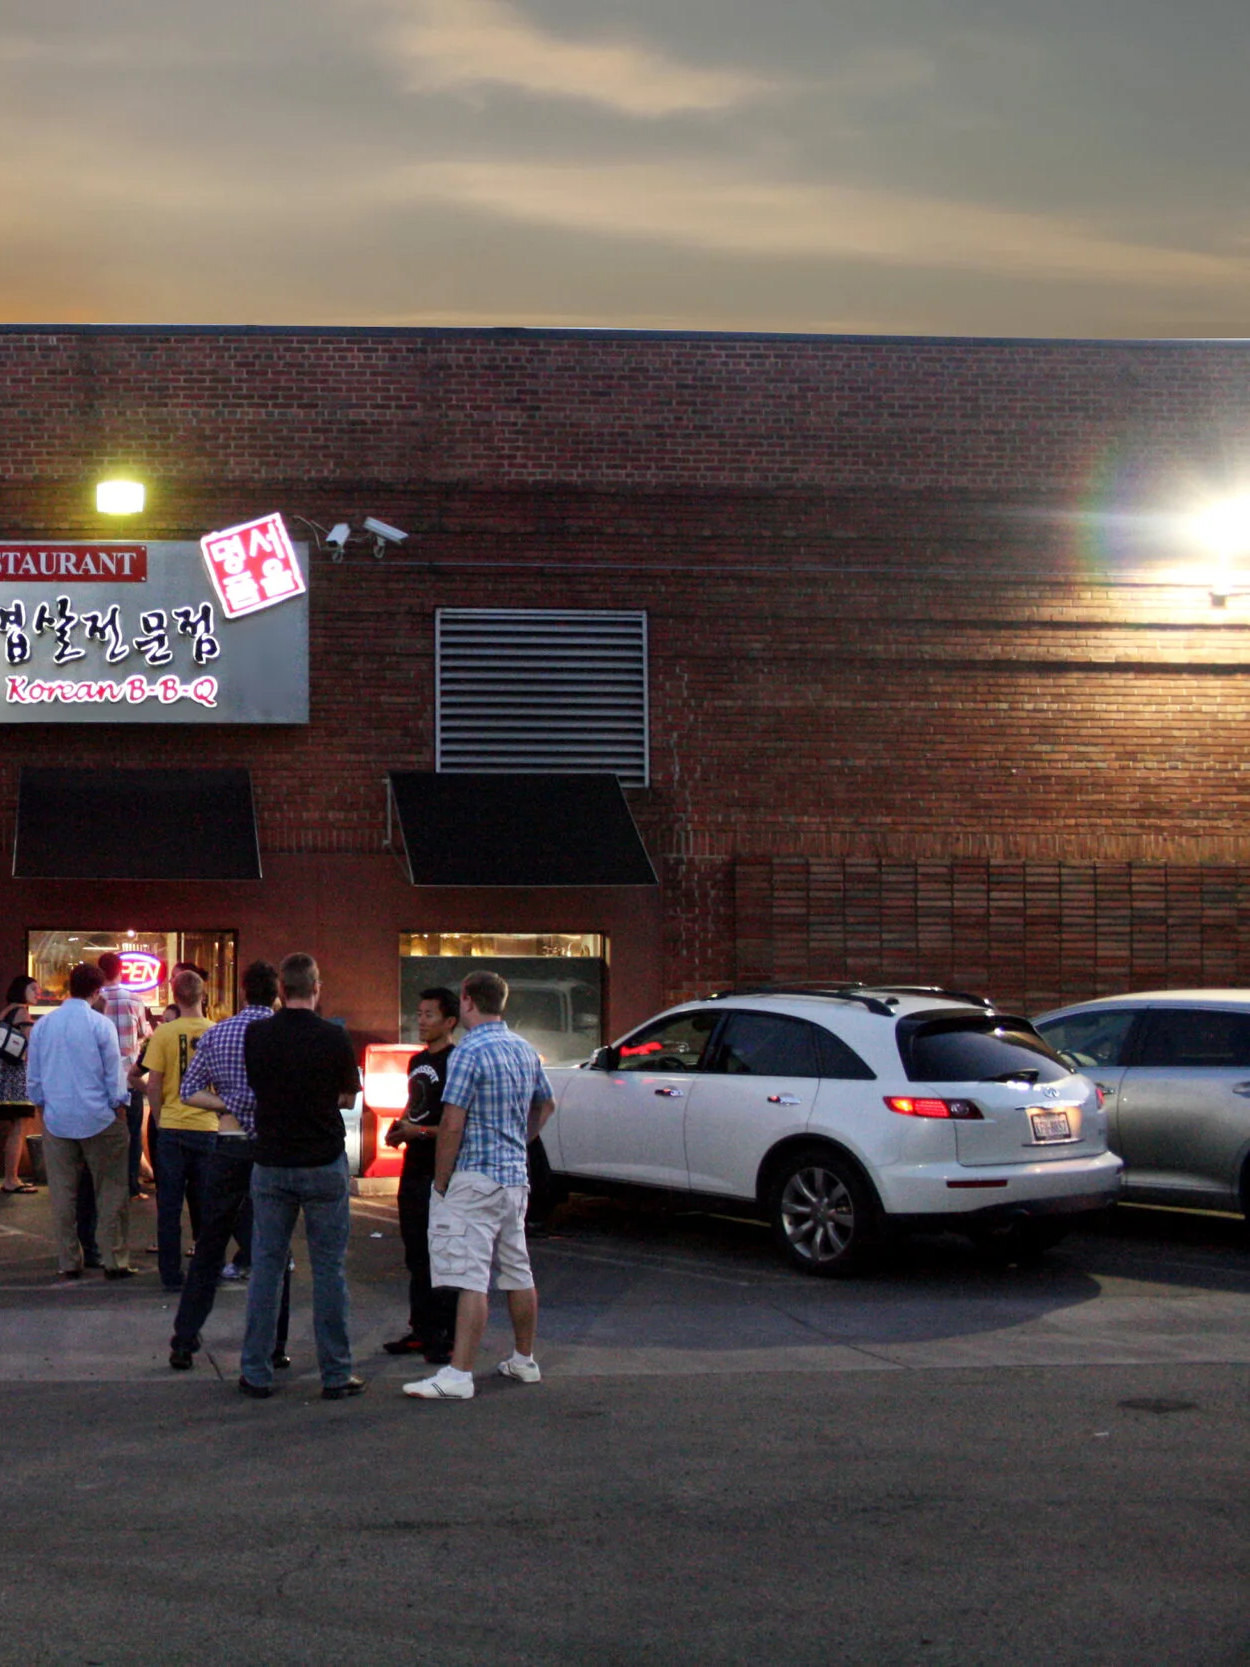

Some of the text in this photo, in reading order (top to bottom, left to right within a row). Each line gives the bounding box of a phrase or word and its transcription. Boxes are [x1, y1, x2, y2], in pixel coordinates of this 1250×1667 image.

[6, 675, 123, 704] Korean
[126, 675, 217, 706] B-B-Q
[121, 962, 161, 982] PEN
